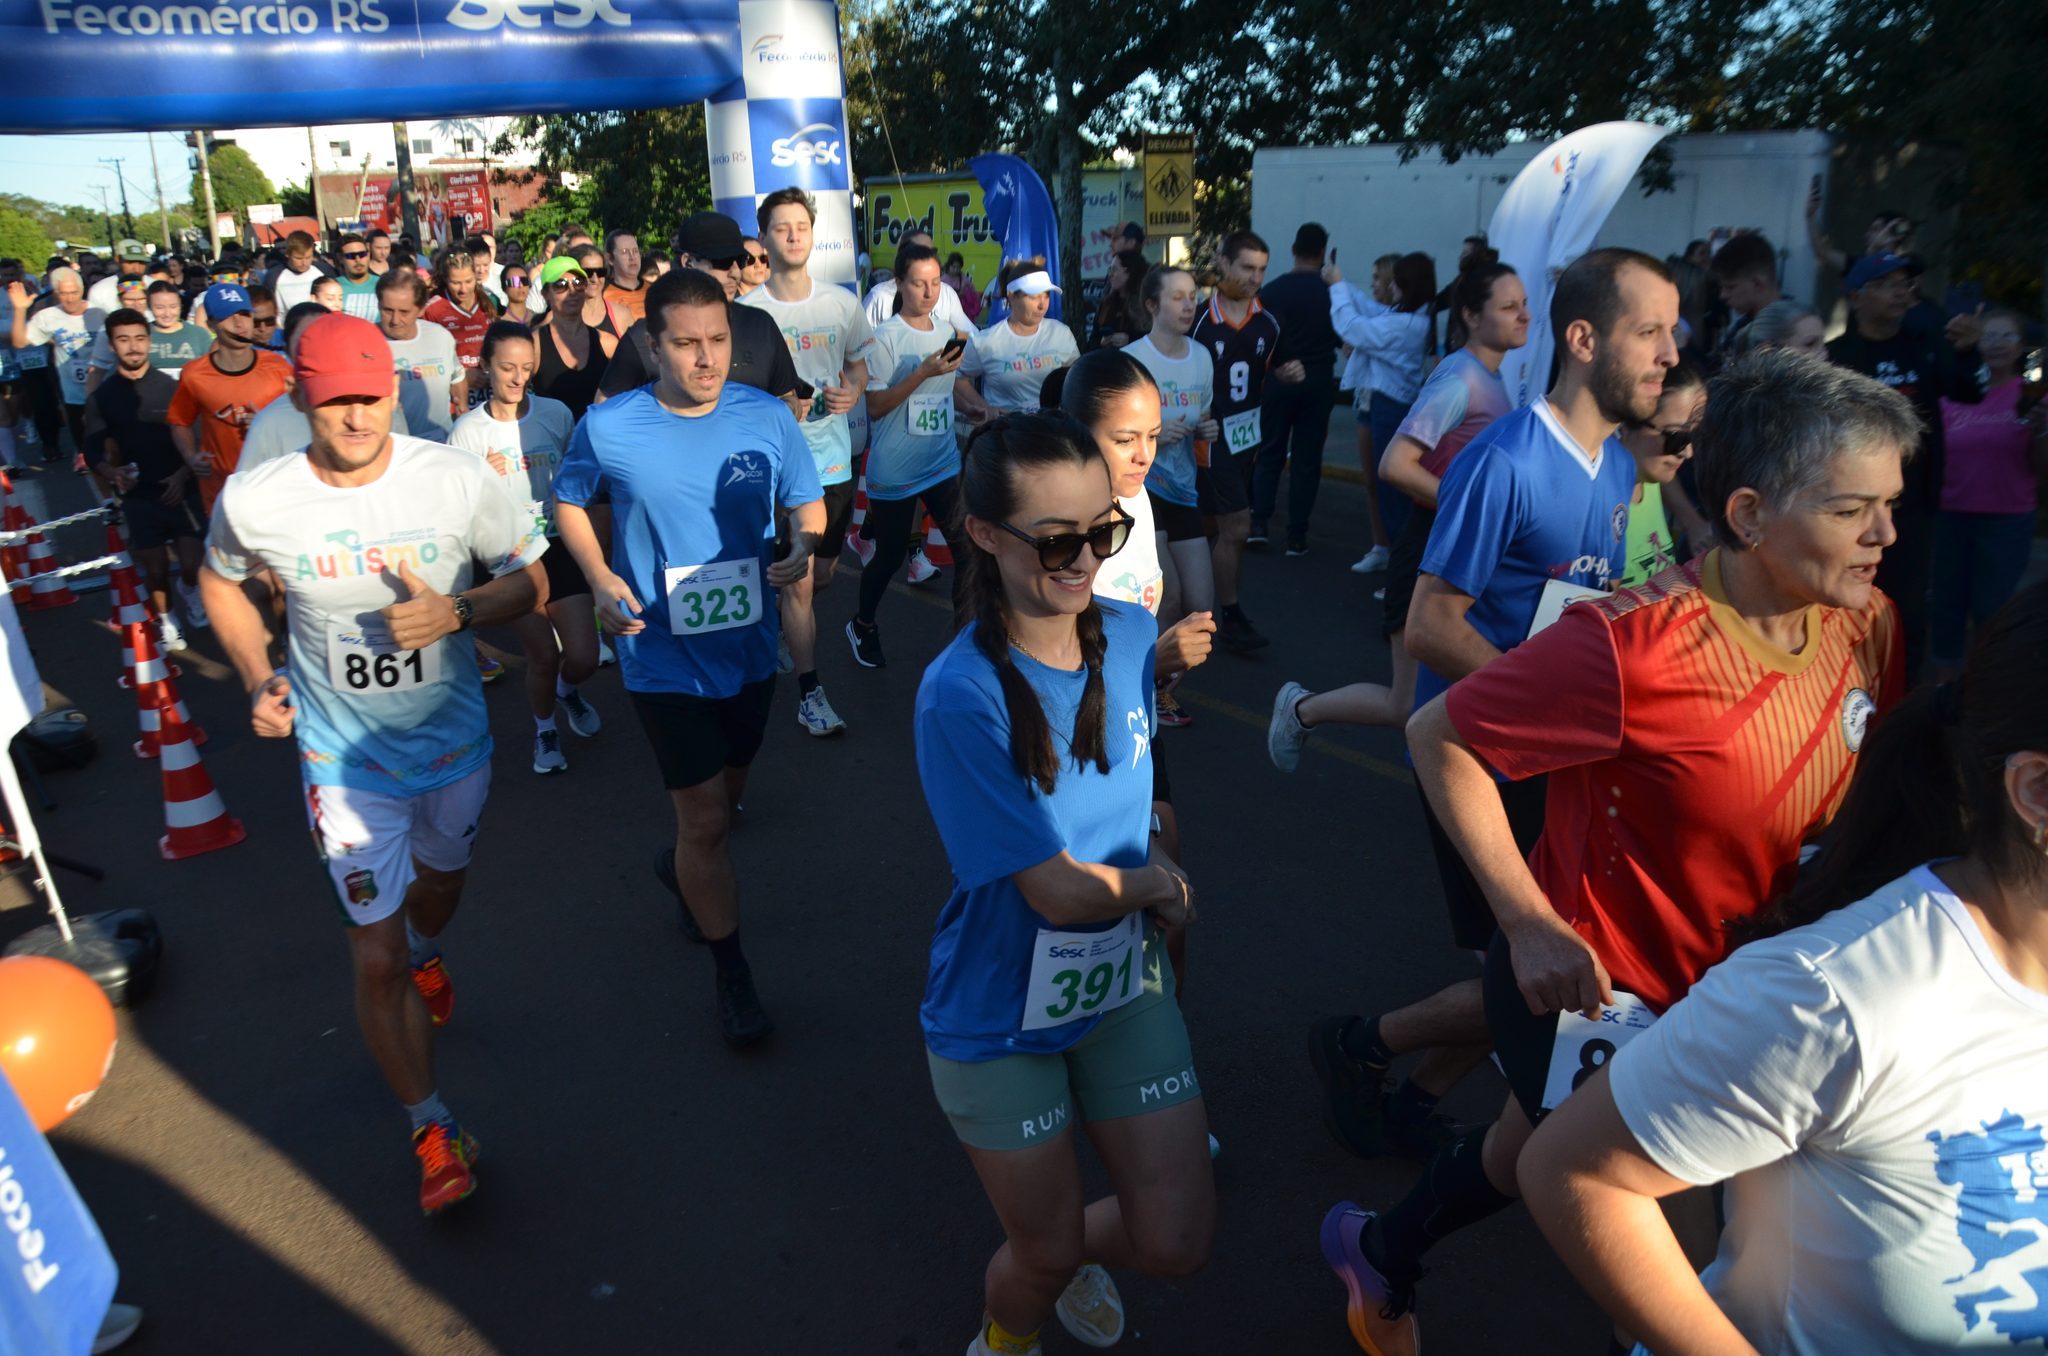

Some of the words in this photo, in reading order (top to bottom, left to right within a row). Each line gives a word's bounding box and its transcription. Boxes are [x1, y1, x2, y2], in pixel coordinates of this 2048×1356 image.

[42, 0, 319, 35] Fecomércio
[332, 0, 389, 33] RS
[771, 138, 841, 166] Sesc
[872, 192, 935, 246] Food
[1149, 211, 1190, 225] ELEVADA
[1230, 361, 1250, 402] 9
[916, 408, 948, 431] 451
[1231, 422, 1257, 447] 421
[296, 542, 439, 581] Autismo
[682, 585, 751, 628] 323
[345, 649, 423, 689] 861
[1048, 945, 1086, 959] Sesc
[1045, 945, 1133, 1018] 391
[1022, 1104, 1065, 1139] RUN
